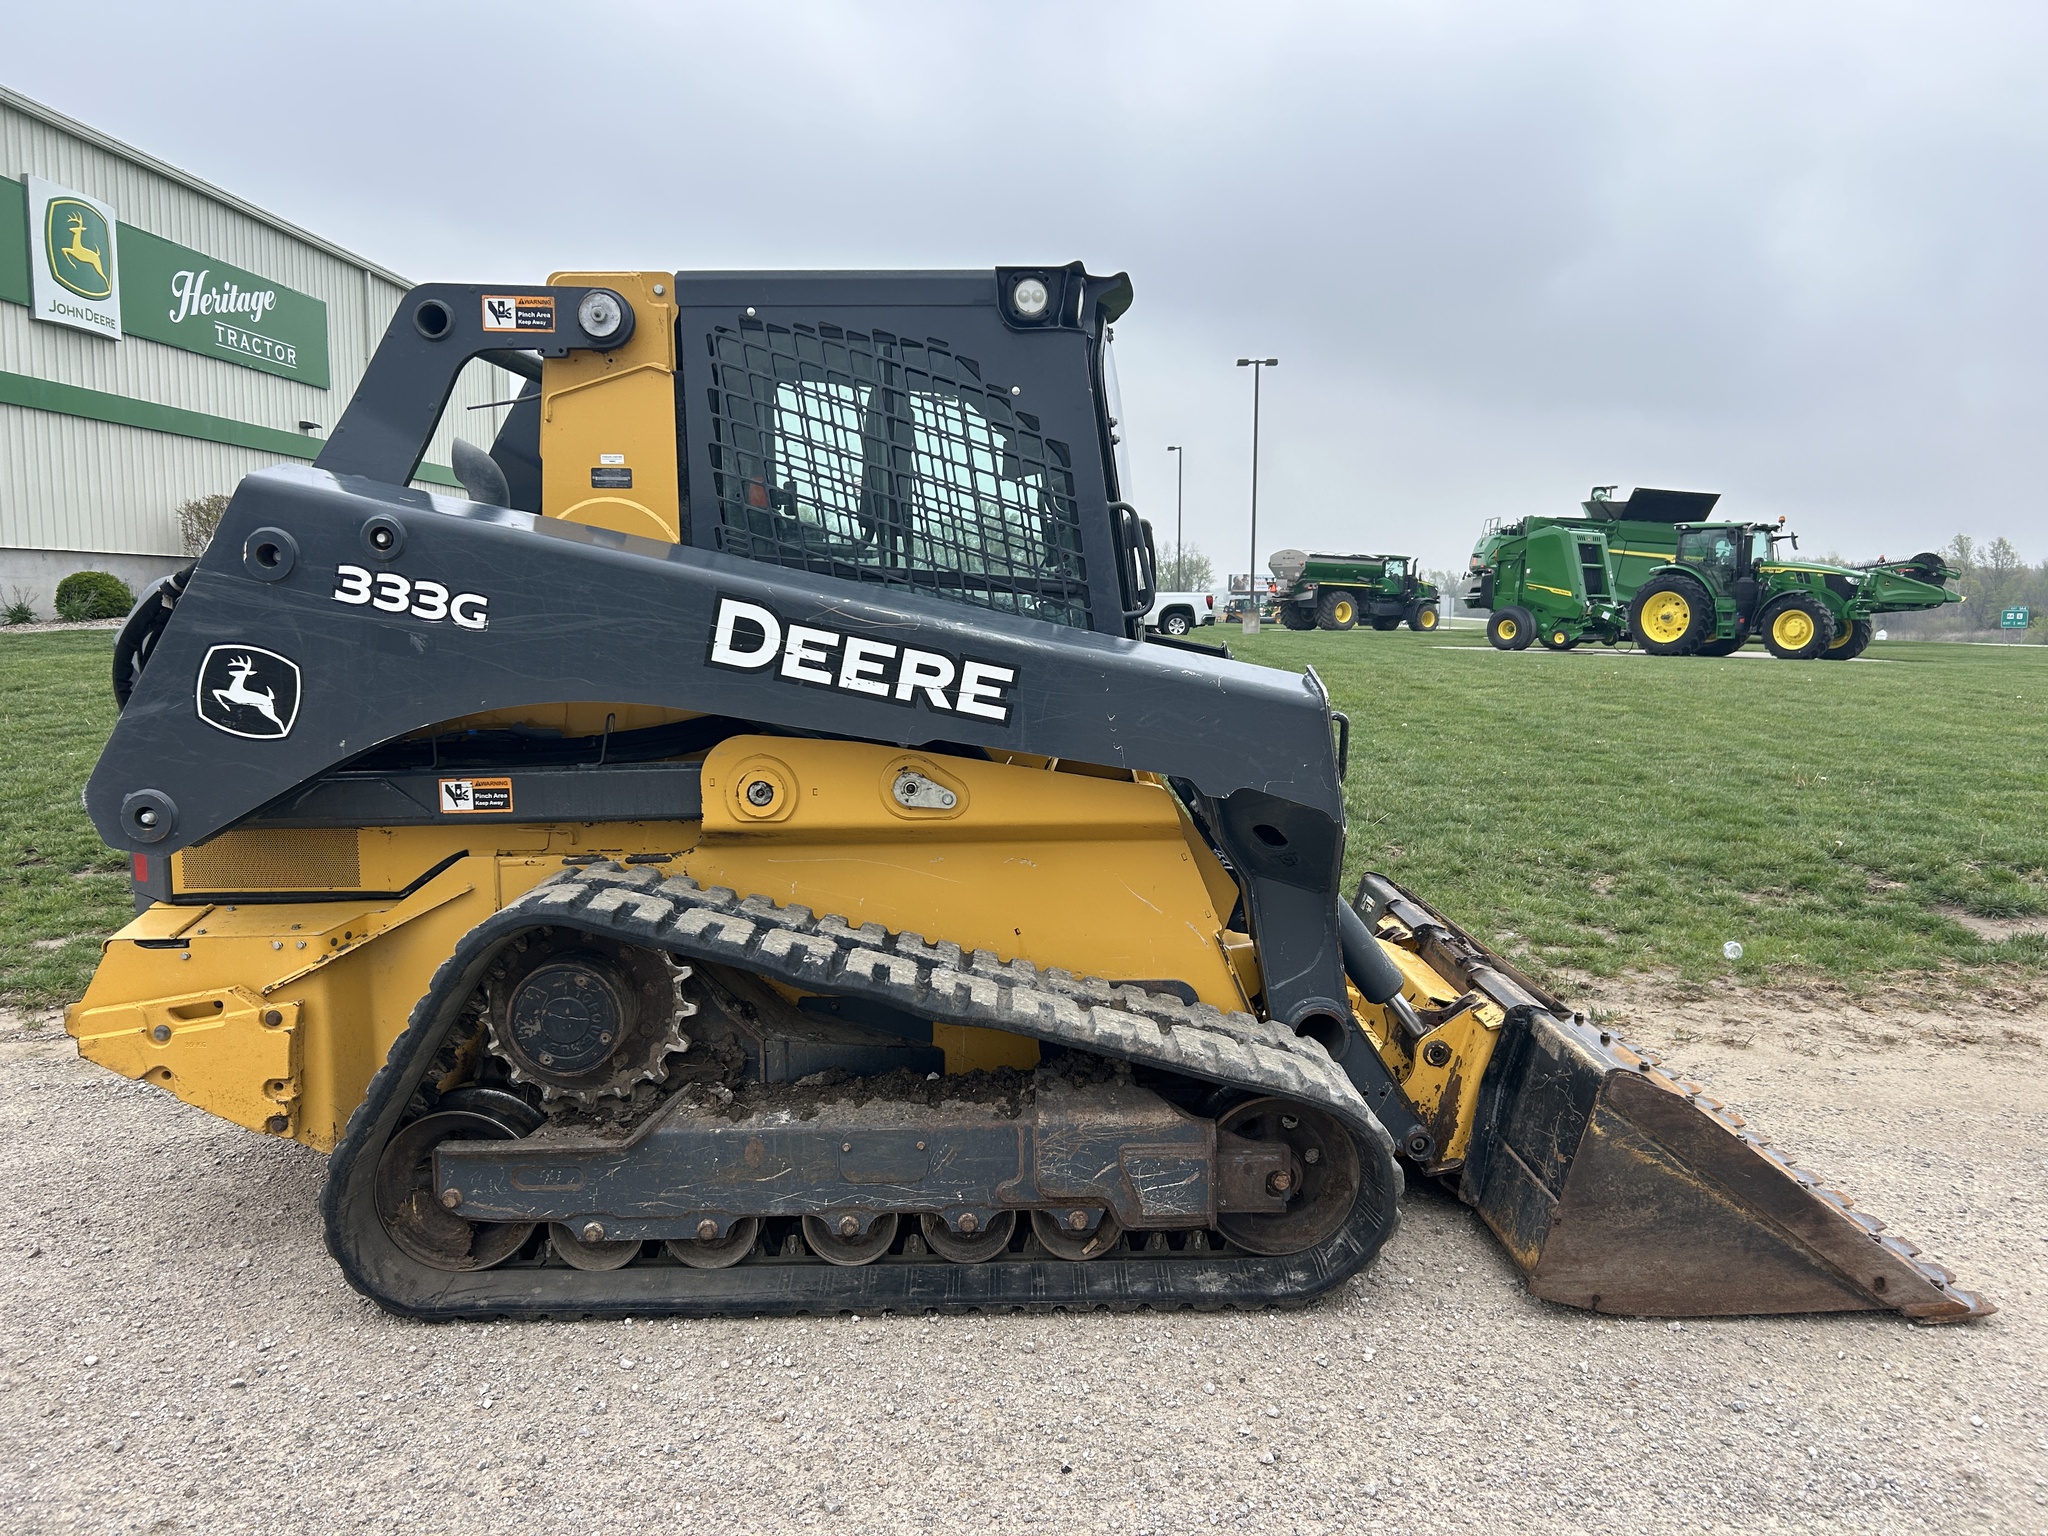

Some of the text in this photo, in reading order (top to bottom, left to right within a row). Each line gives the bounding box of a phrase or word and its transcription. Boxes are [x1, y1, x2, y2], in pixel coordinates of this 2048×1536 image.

[49, 300, 116, 330] JOHN DEERE
[169, 269, 277, 323] Heritage
[214, 324, 297, 365] TRACTOR
[333, 564, 489, 630] 333G
[711, 598, 1015, 721] DEERE
